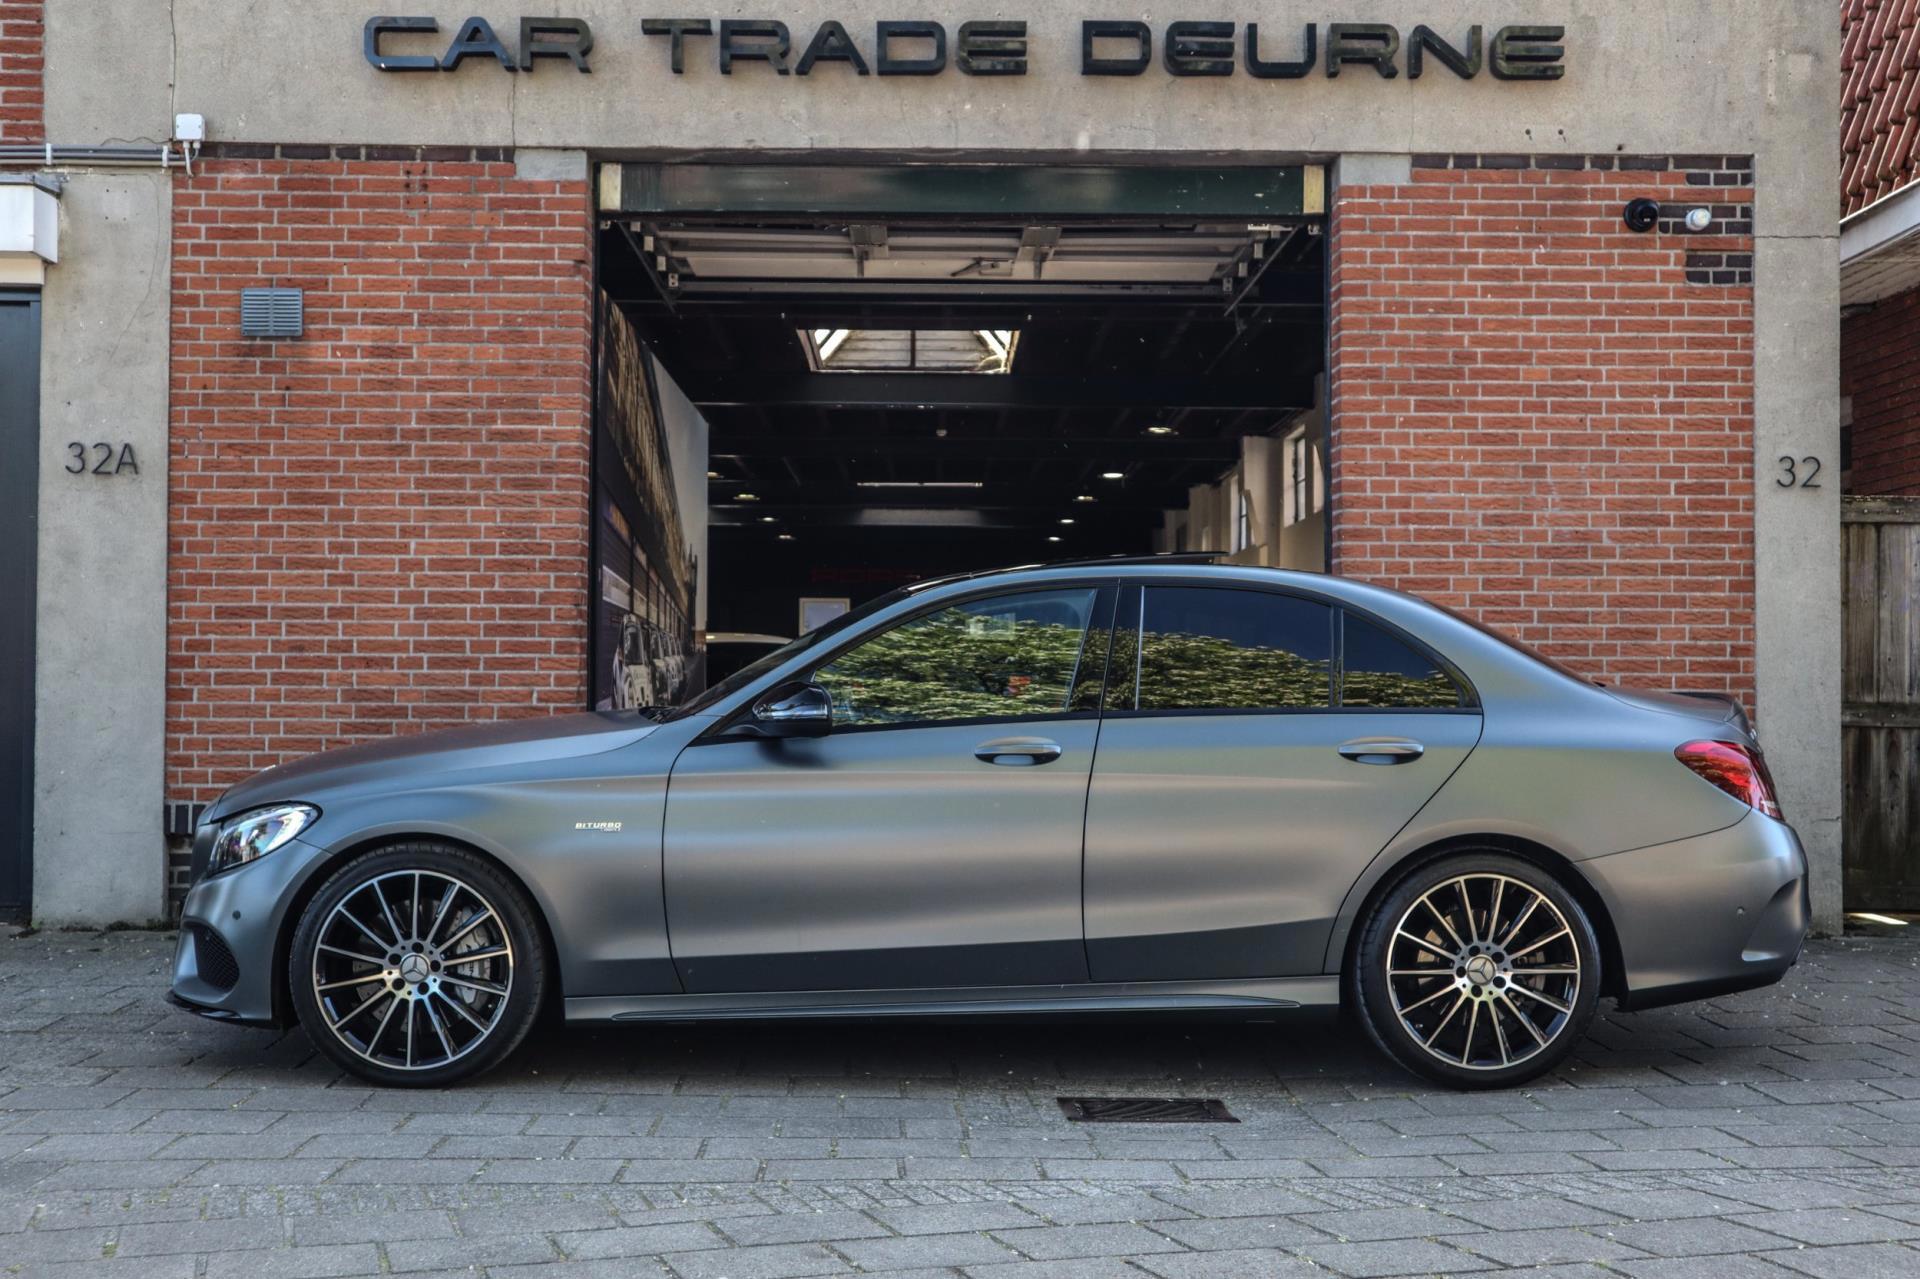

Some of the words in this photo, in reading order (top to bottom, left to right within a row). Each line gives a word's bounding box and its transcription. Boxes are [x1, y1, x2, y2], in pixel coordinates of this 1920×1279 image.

[364, 16, 594, 73] CAR
[641, 18, 1027, 76] TRADE
[1082, 20, 1565, 80] DEURNE
[65, 442, 139, 475] 32A
[1776, 456, 1821, 488] 32
[574, 822, 622, 830] BITURBO
